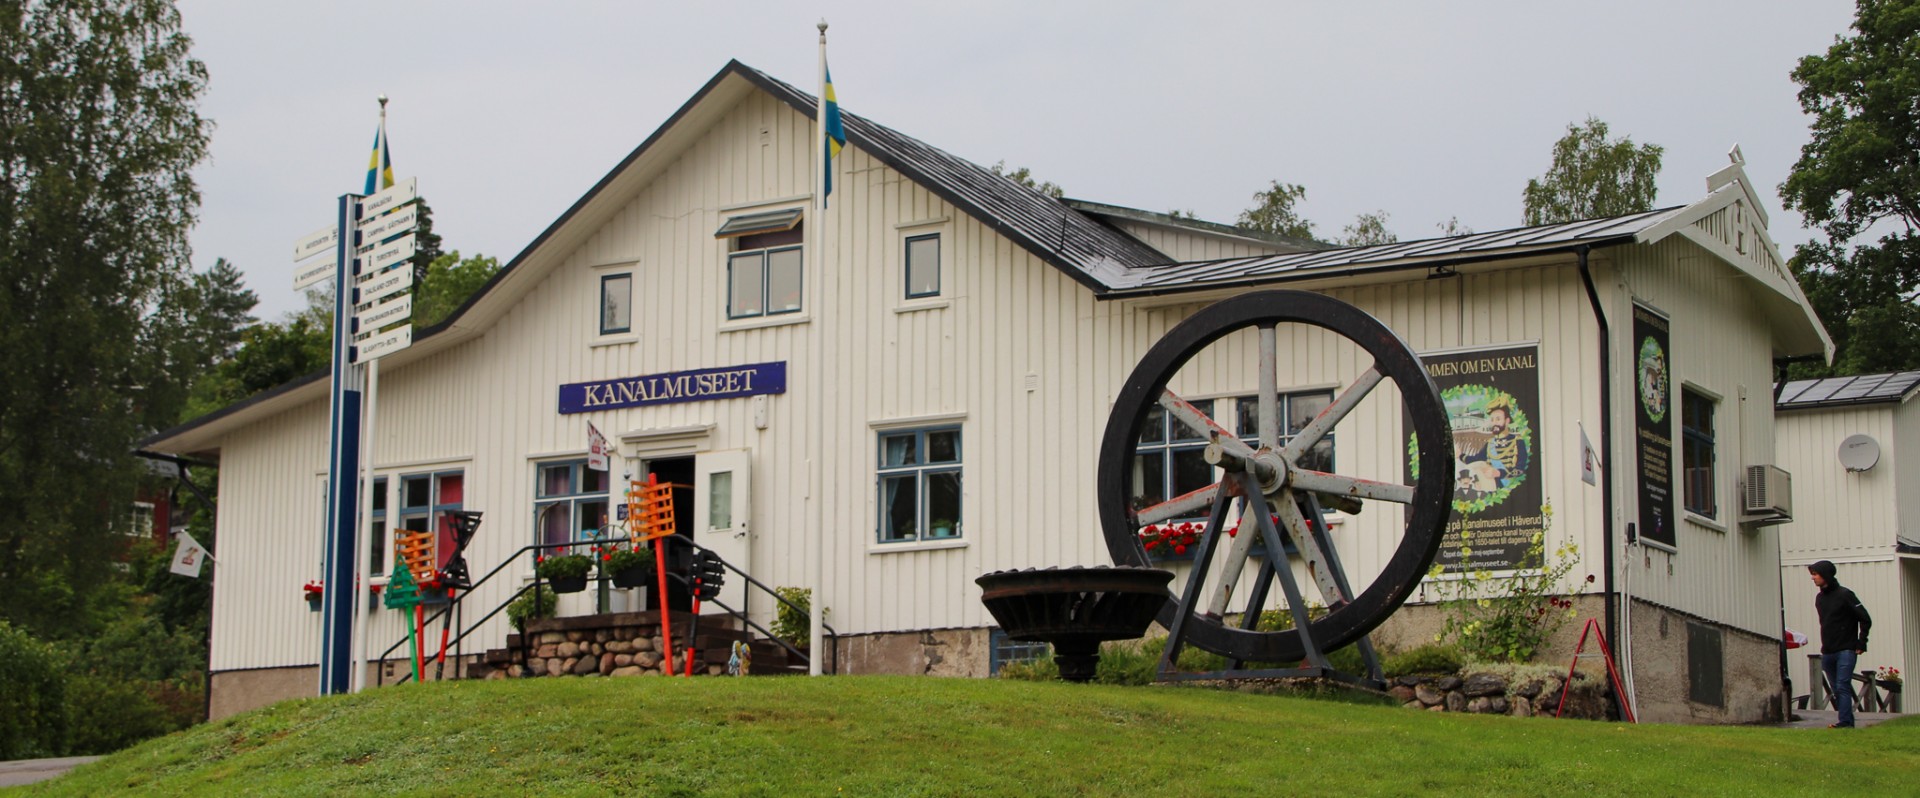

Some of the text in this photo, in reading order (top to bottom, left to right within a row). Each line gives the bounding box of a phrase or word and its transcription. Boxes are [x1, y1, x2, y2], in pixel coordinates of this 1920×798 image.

[1460, 360, 1478, 375] OM
[1480, 359, 1495, 373] EN
[1497, 355, 1536, 371] KANAL
[583, 369, 757, 407] KANALMUSEET
[1452, 519, 1461, 532] på
[1512, 514, 1542, 526] Håverud
[1477, 529, 1503, 539] Dalslands
[1503, 528, 1519, 536] kanal
